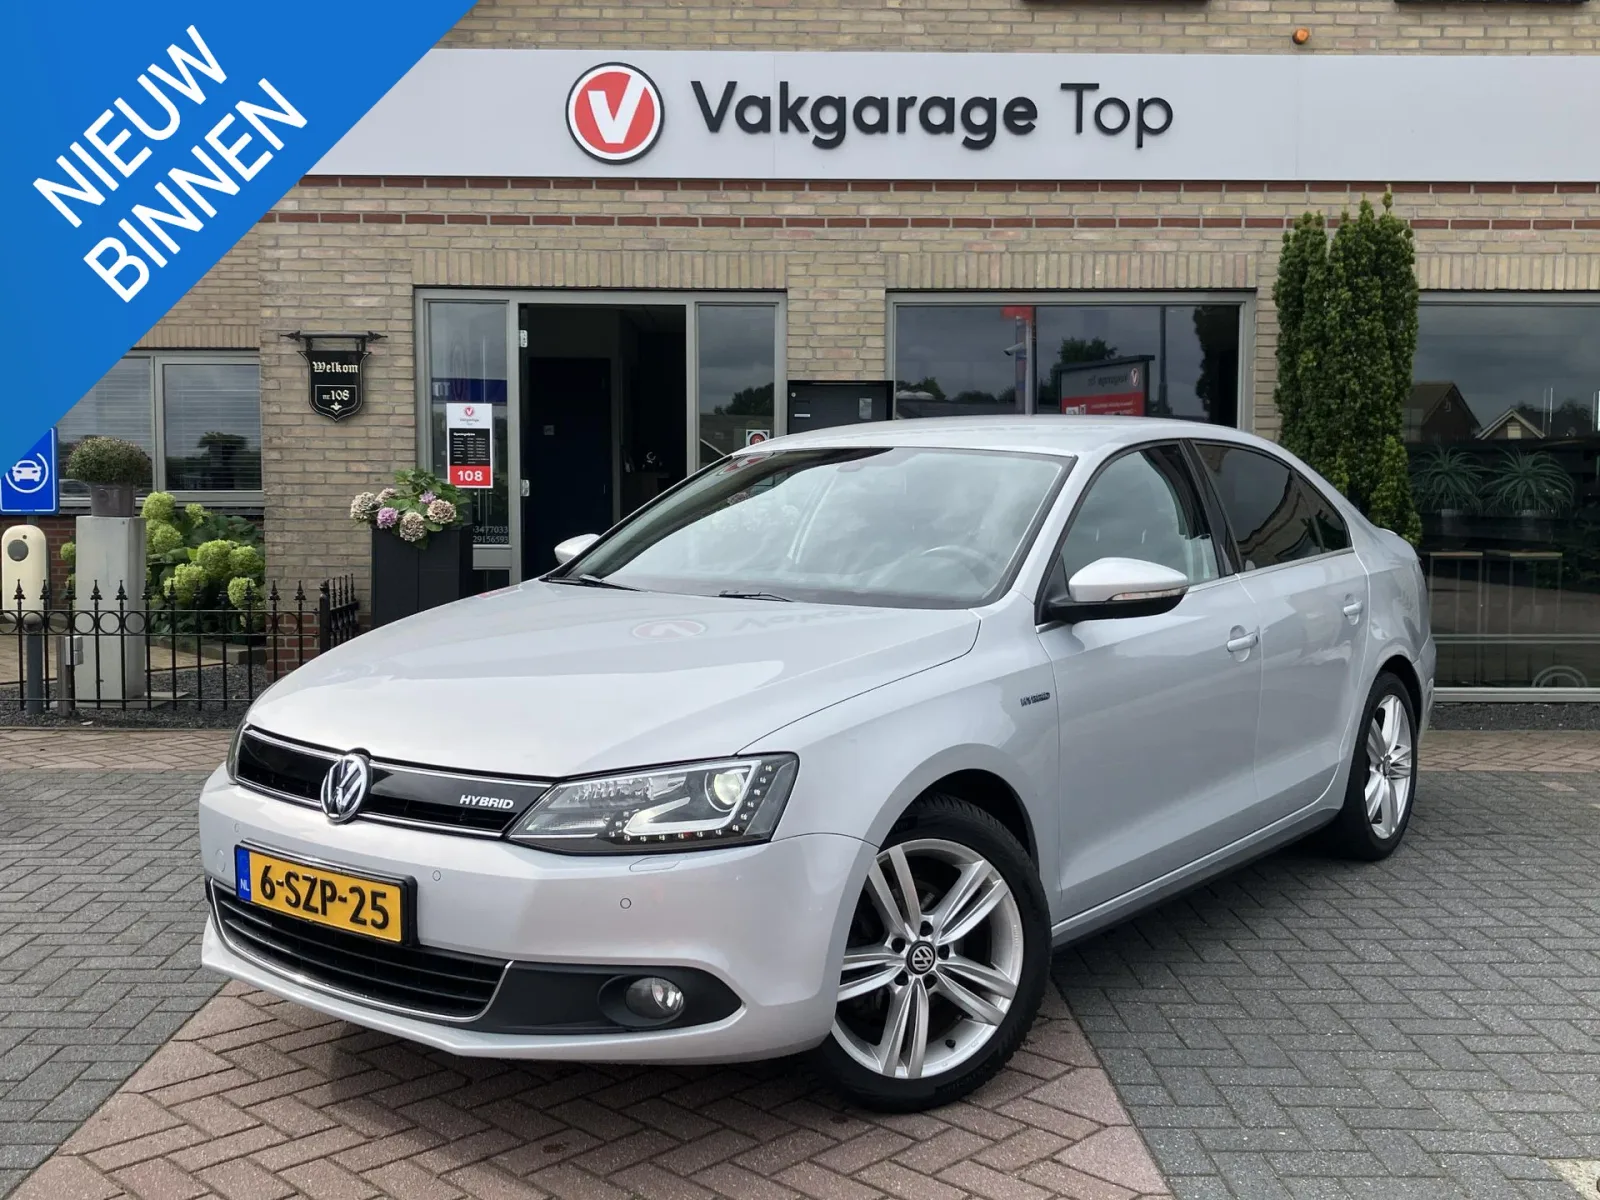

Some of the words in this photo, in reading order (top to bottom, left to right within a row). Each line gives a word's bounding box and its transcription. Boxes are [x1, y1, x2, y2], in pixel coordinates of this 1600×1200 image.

[690, 80, 1038, 150] Vakgarage
[1060, 82, 1175, 149] Top
[312, 361, 359, 373] Welkom
[457, 470, 483, 482] 108
[472, 525, 509, 534] 3477033
[459, 794, 514, 809] HYBRID
[240, 878, 250, 892] NL
[260, 864, 391, 930] 6-SZP-25
